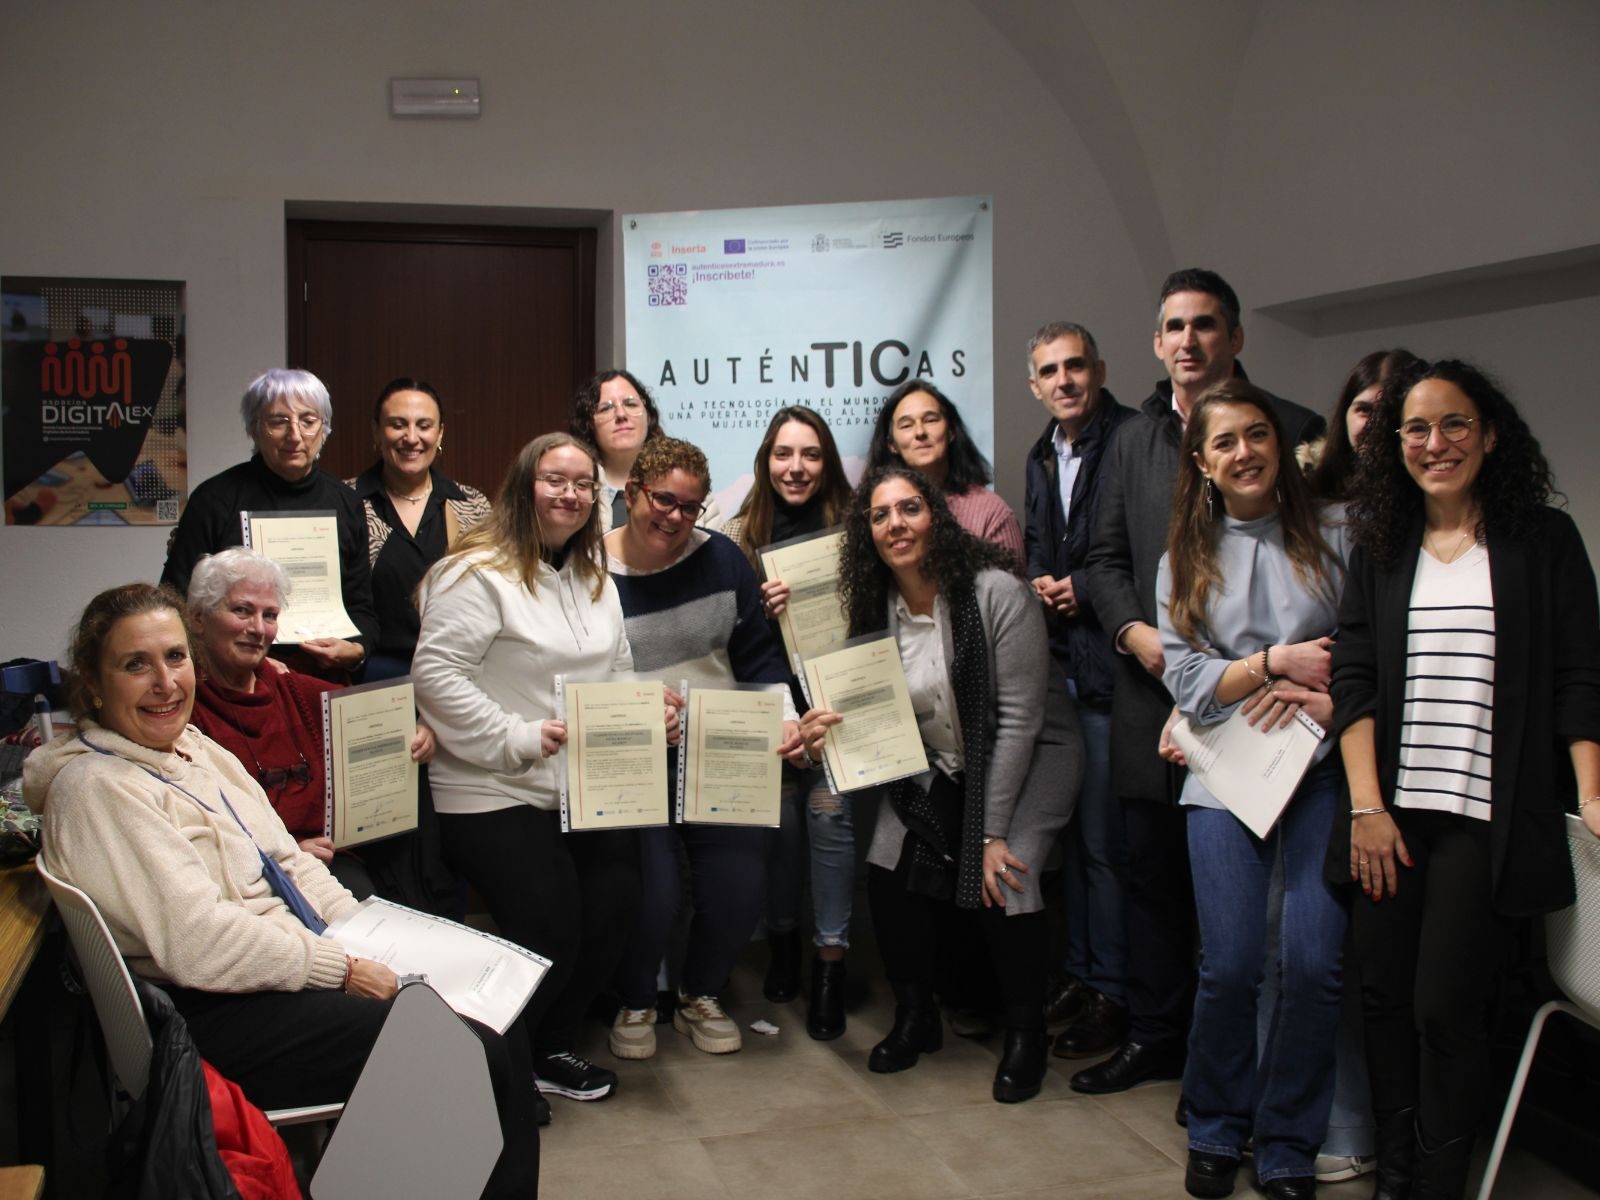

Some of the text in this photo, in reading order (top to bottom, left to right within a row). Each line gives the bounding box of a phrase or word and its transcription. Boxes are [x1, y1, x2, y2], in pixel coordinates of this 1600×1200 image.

[907, 235, 936, 243] Fondos
[672, 245, 706, 255] Inserta
[681, 401, 695, 410] LA
[704, 398, 786, 410] TECNOLOGÍA
[820, 398, 833, 406] EL
[843, 396, 889, 406] MUNDO
[668, 407, 855, 420] UNA PUERTA DE AL
[712, 419, 768, 429] MUJERES
